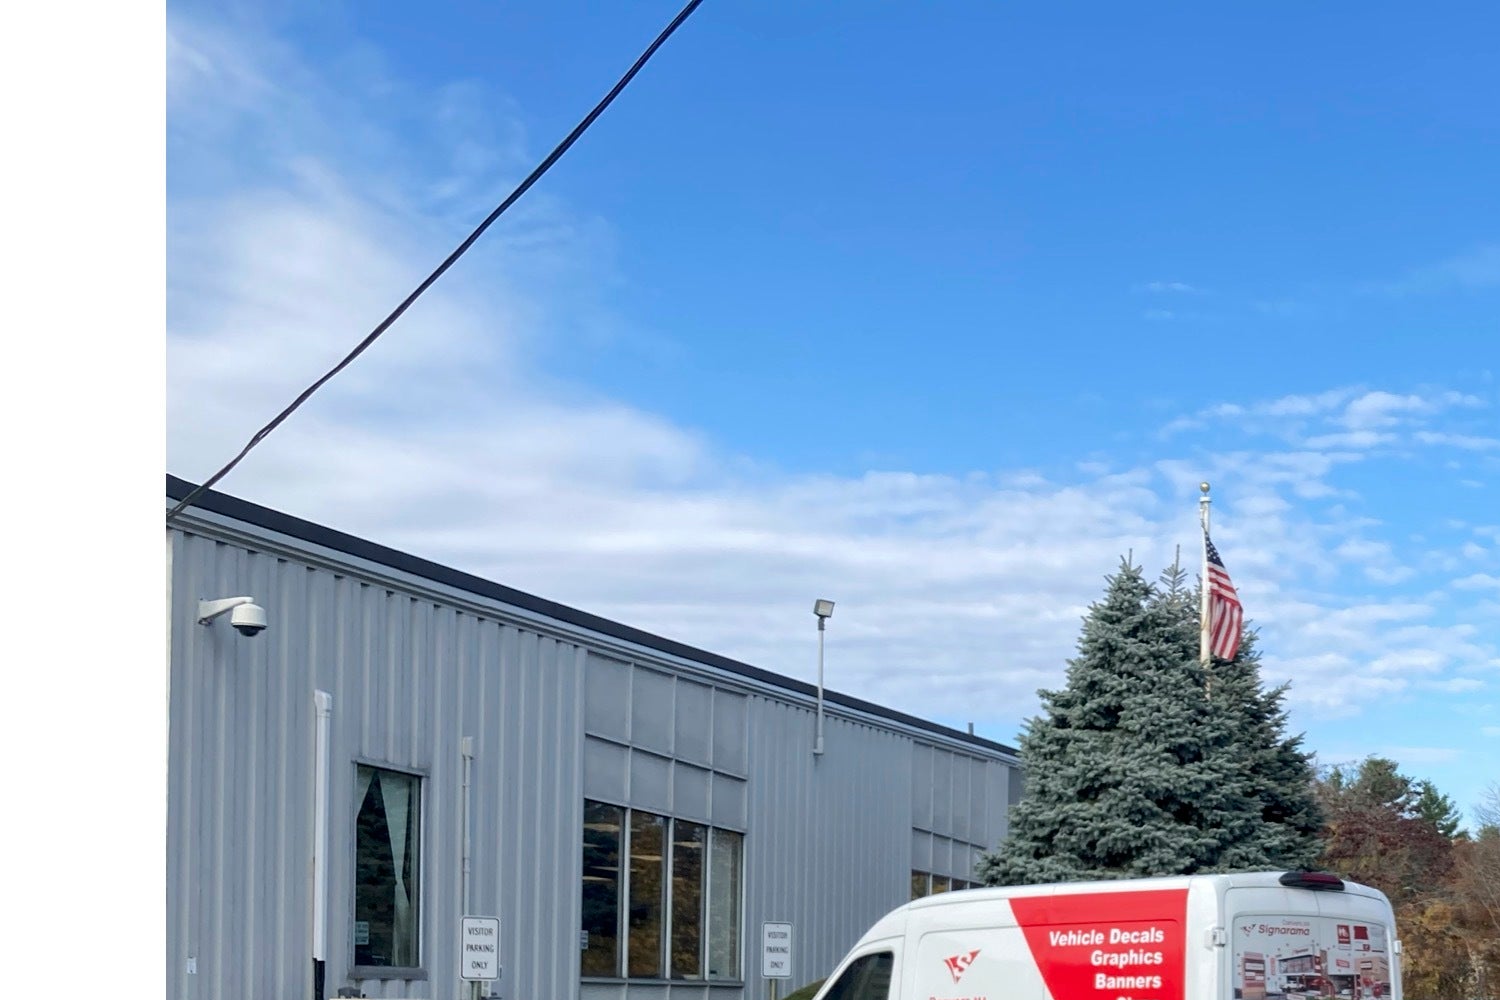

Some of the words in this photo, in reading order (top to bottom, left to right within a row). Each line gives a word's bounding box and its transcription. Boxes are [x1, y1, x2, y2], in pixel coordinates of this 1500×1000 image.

[468, 927, 493, 936] VISITOR
[1258, 924, 1310, 936] Signarama
[1049, 930, 1104, 946] Vehicle
[1109, 928, 1164, 944] Decals
[466, 944, 494, 952] PARKING
[1091, 949, 1163, 968] Graphics
[471, 961, 488, 969] ONLY
[1095, 973, 1162, 989] Banners
